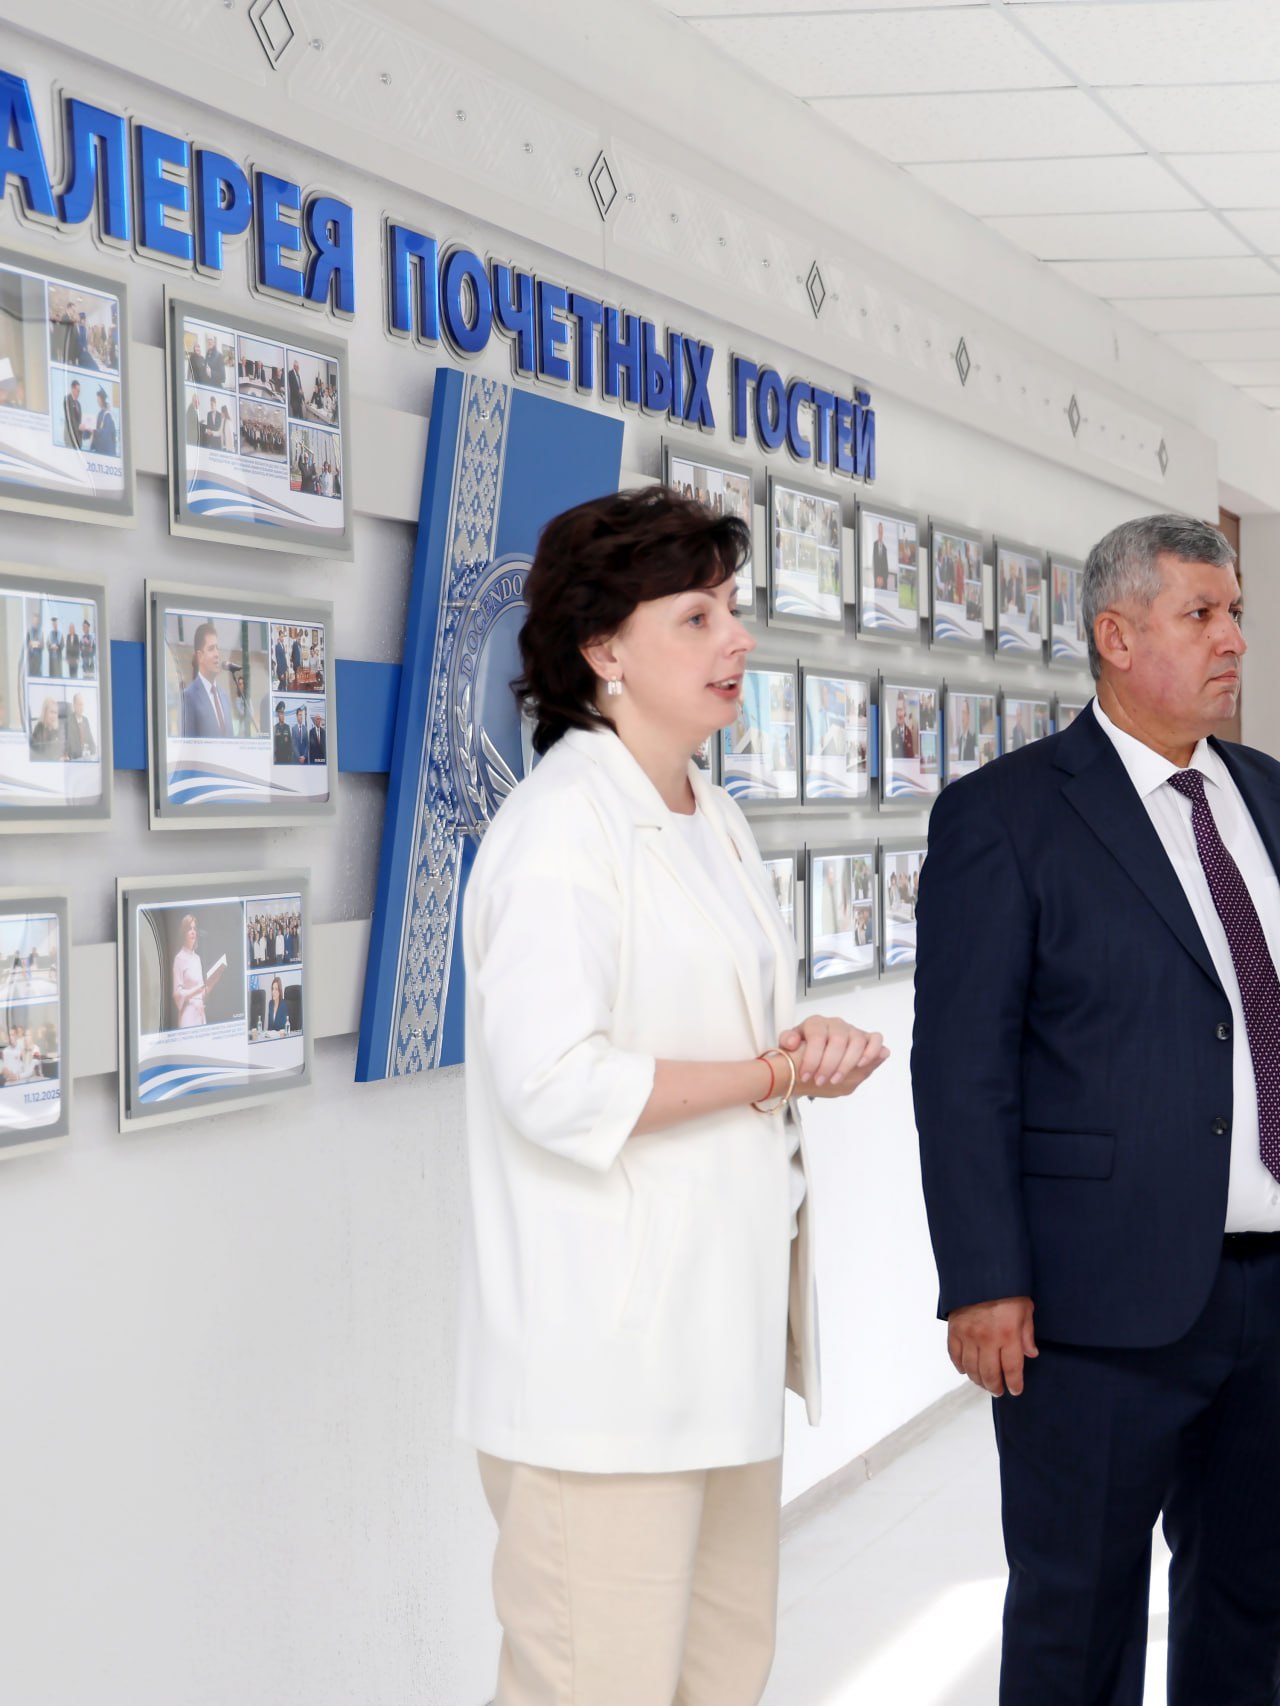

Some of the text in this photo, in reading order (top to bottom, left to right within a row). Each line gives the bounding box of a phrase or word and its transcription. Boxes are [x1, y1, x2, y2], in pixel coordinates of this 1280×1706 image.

[389, 224, 716, 429] ПОЧЕТНЫХ
[733, 355, 876, 481] ГОСТЕЙ
[460, 574, 524, 682] DOCENDO
